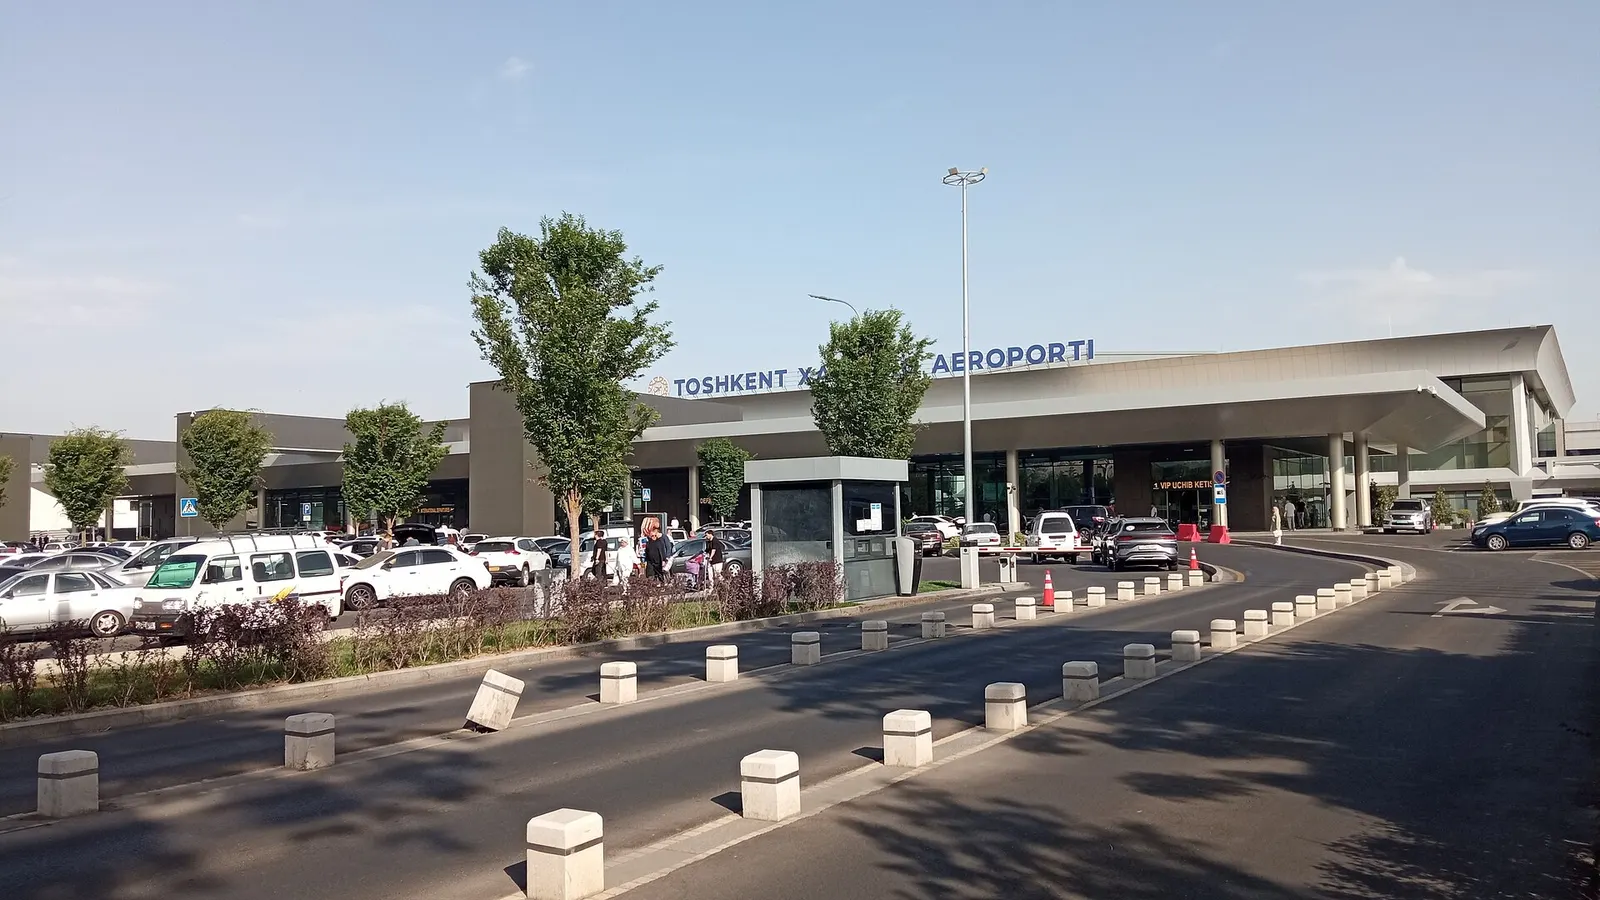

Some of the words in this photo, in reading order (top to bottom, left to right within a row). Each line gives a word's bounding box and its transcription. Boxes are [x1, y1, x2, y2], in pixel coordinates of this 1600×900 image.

[673, 369, 788, 396] TOSHKENT
[931, 339, 1094, 374] AEROPORTI
[1160, 481, 1171, 489] VIP
[1172, 480, 1193, 489] UCHIB
